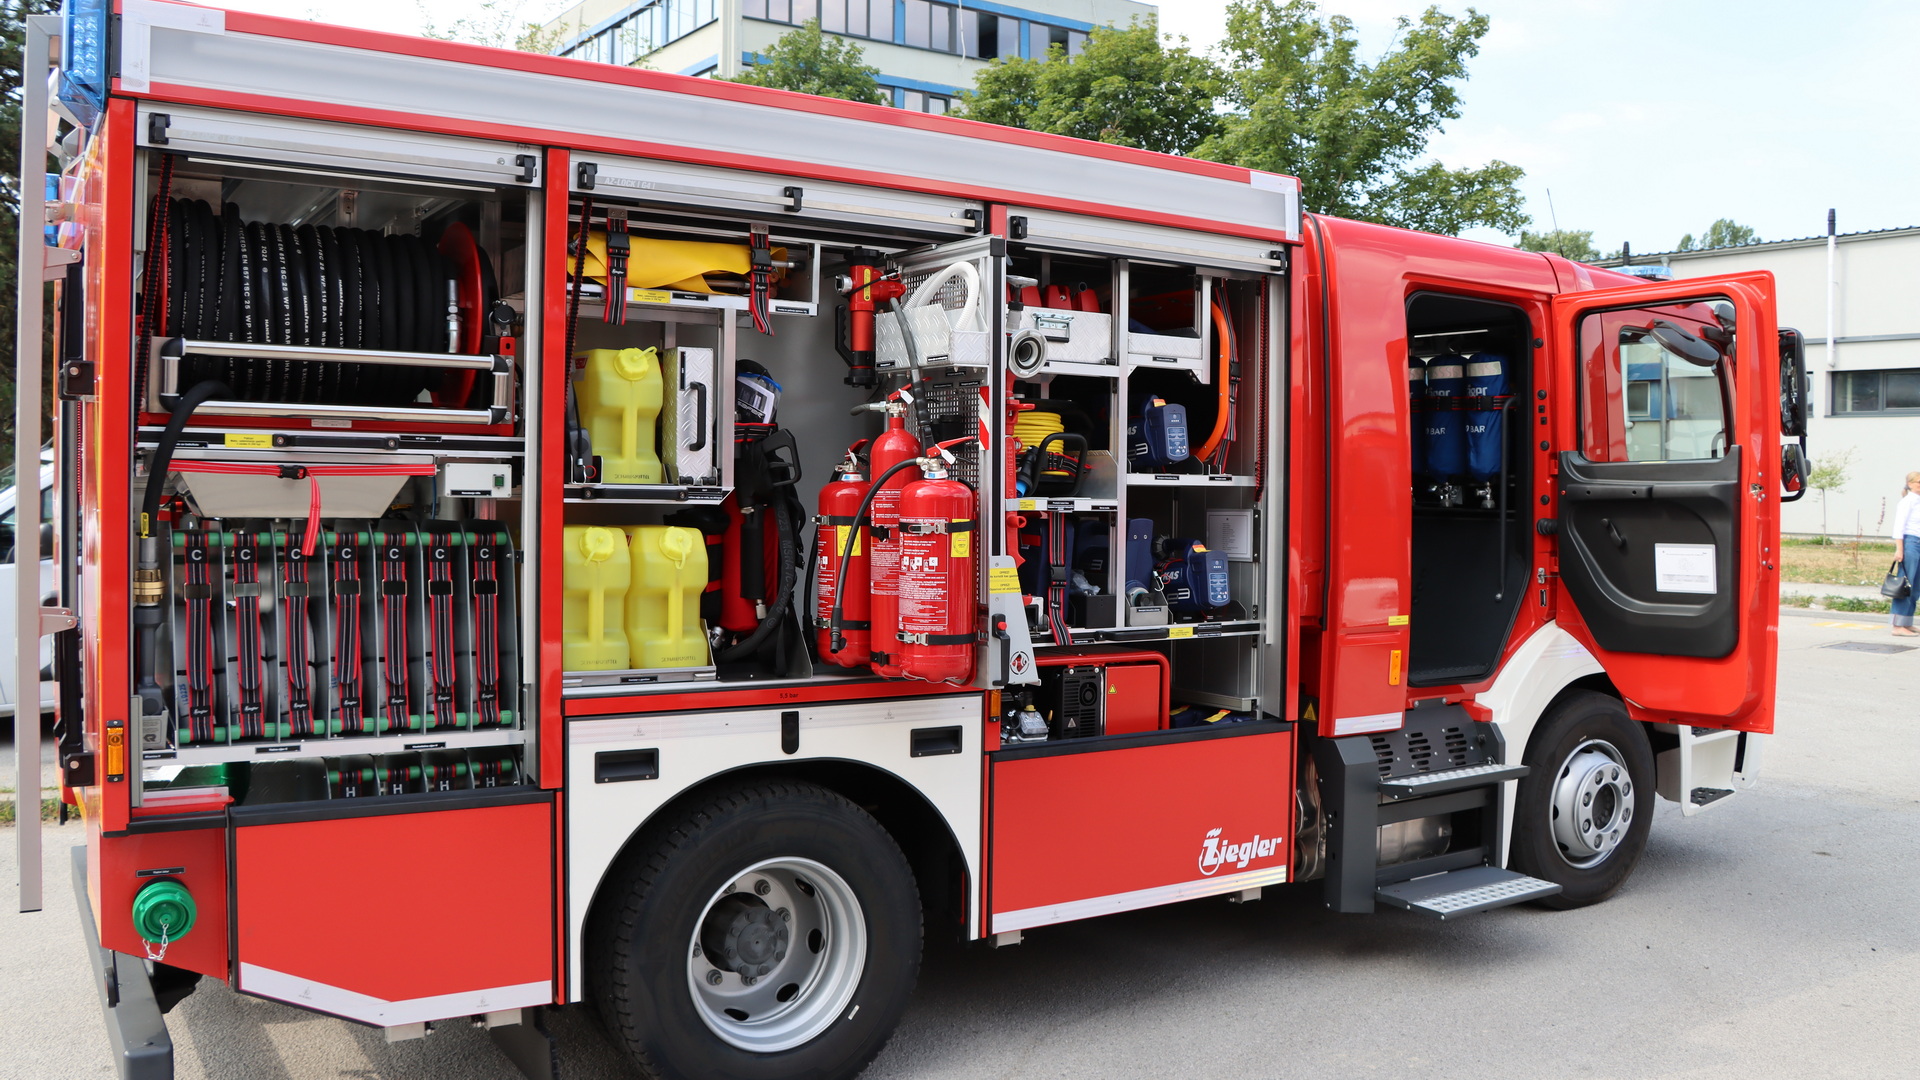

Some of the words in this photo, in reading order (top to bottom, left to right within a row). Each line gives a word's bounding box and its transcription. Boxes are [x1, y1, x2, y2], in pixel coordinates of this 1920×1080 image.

[242, 254, 249, 264] EN
[321, 275, 327, 287] WP
[283, 296, 290, 310] WP
[245, 315, 252, 328] WP
[1470, 425, 1486, 433] BAR
[191, 549, 202, 561] C
[240, 549, 251, 560] C
[290, 548, 301, 560] C
[341, 547, 352, 559] C
[389, 547, 399, 559] C
[435, 548, 445, 559] C
[479, 547, 490, 559] C
[440, 780, 450, 791] H
[486, 776, 495, 787] H
[346, 786, 356, 798] H
[393, 783, 403, 795] H
[1200, 831, 1283, 873] Ziegler
